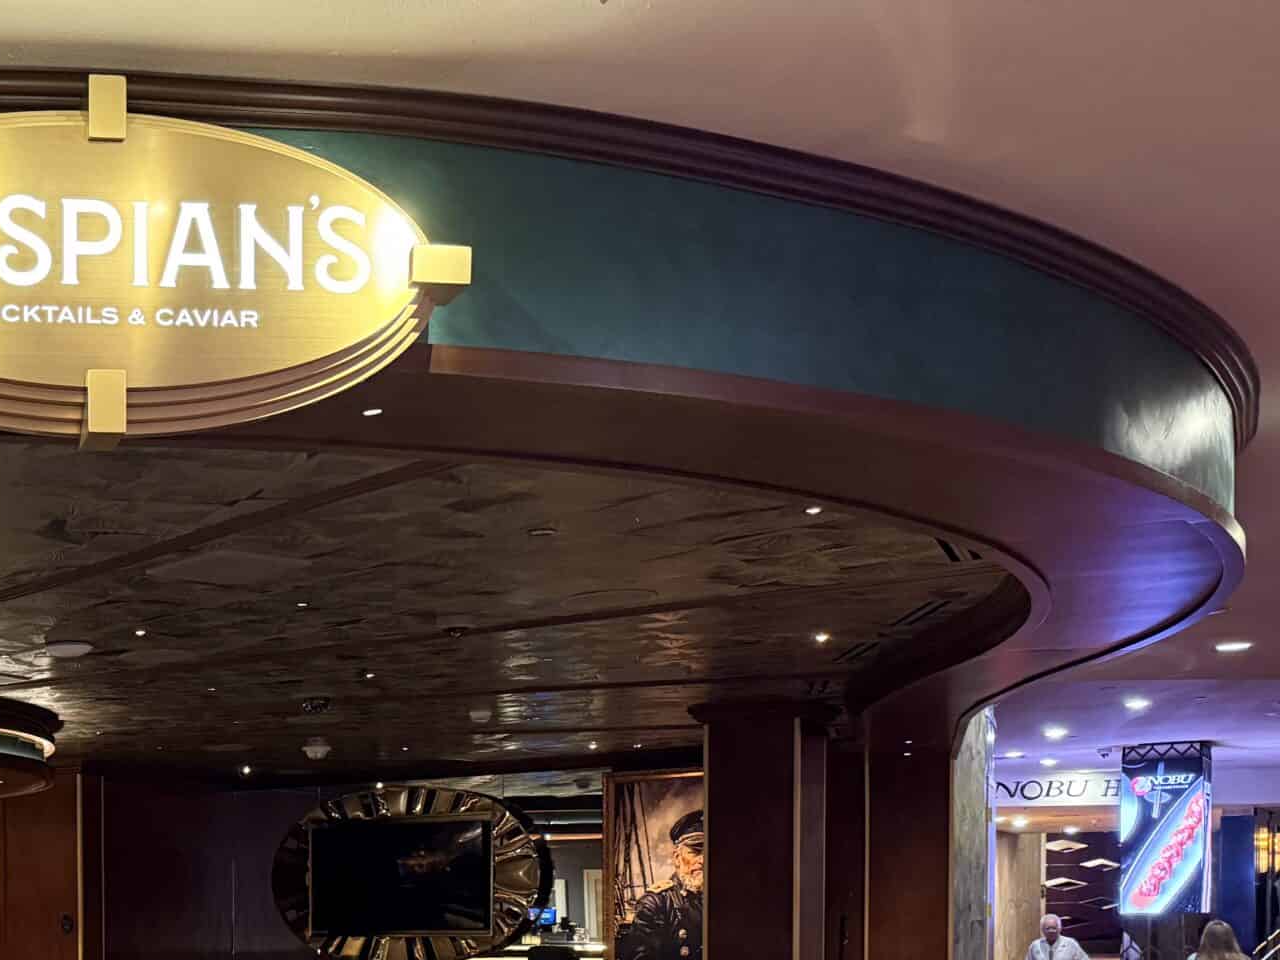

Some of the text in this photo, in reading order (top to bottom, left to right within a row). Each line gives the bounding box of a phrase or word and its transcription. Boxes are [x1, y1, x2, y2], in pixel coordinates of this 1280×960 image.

[127, 308, 145, 326] &
[155, 308, 260, 328] CAVIAR
[1148, 773, 1196, 785] NOBU
[996, 779, 1088, 800] NOBU
